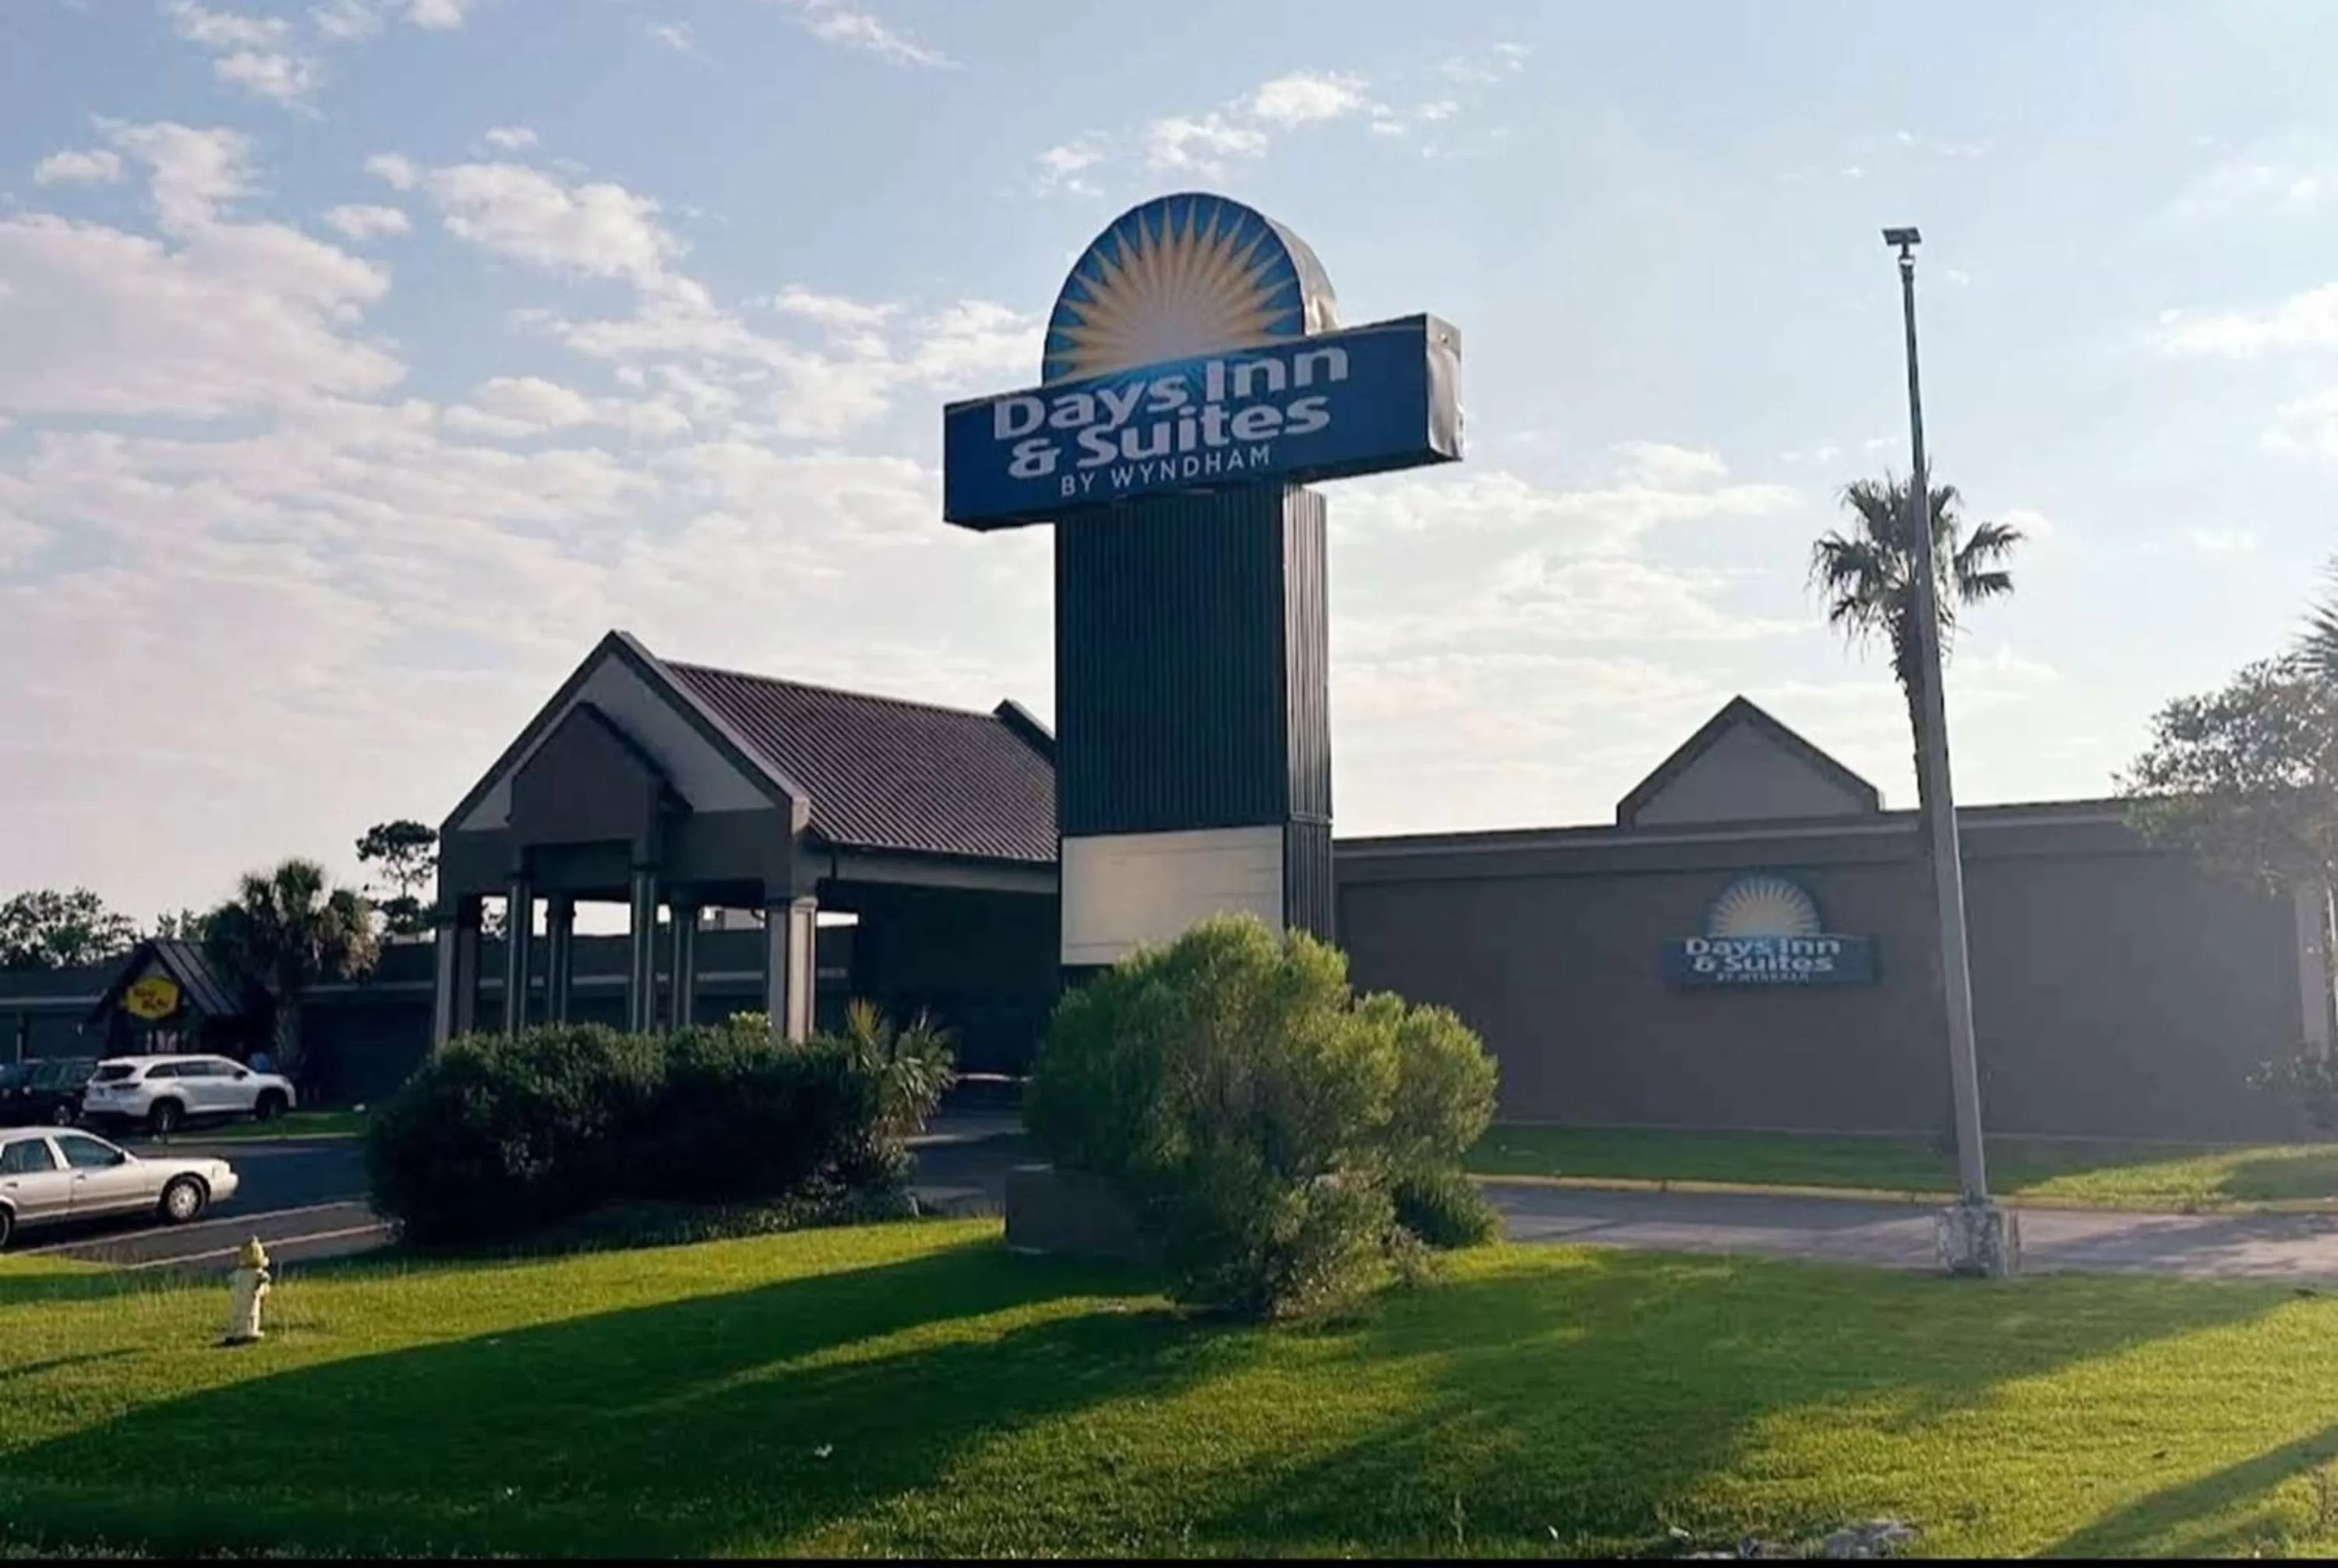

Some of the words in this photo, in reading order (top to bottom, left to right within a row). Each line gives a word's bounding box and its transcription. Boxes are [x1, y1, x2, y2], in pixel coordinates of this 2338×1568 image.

[994, 376, 1186, 441] Days
[1205, 346, 1348, 404] Inn
[1008, 438, 1061, 480] &
[1076, 395, 1331, 470] Suites
[1061, 471, 1096, 497] BY
[1111, 444, 1271, 489] WYNDHAM
[1685, 938, 1771, 959] Days
[1778, 938, 1841, 955] Inn
[1693, 955, 1716, 972] &
[1723, 955, 1834, 973] Suites
